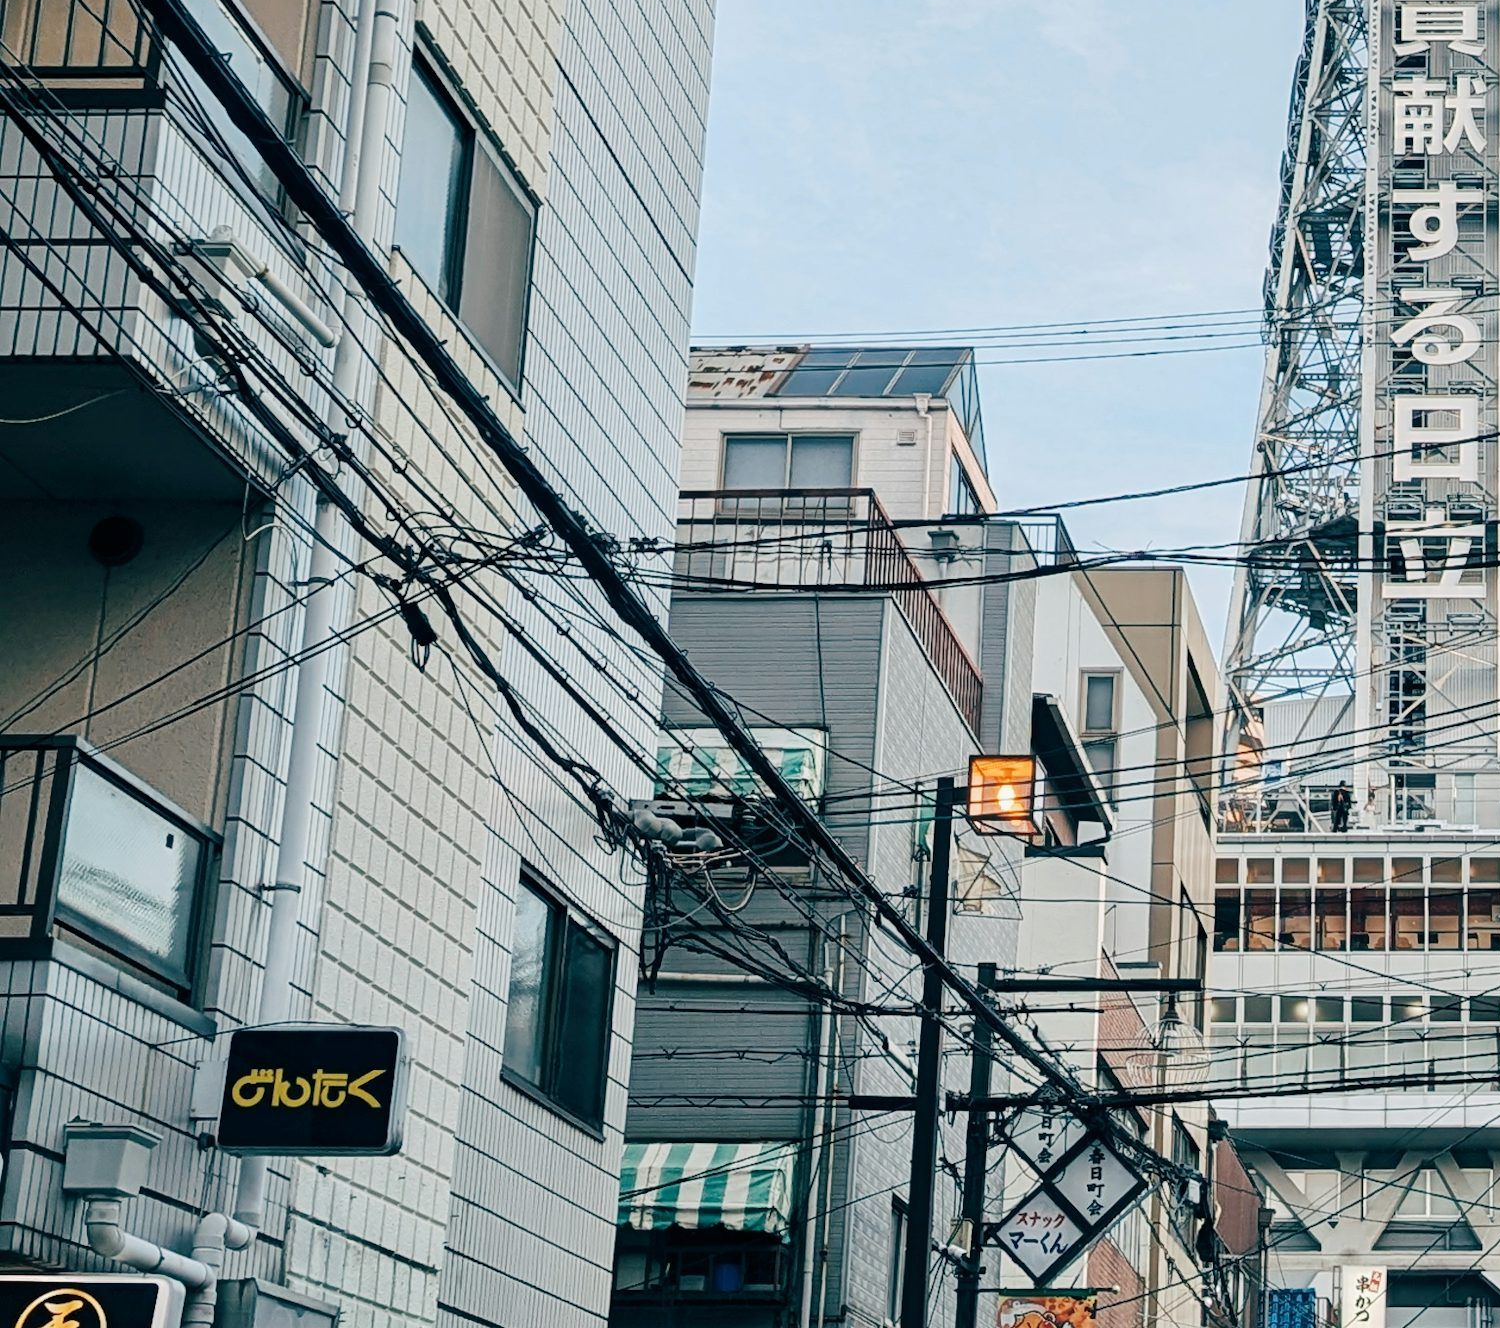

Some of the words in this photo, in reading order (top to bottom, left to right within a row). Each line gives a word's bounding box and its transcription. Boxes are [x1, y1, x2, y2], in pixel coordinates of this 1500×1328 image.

[232, 1068, 386, 1109] どんたく
[1086, 1147, 1106, 1217] 春日町会
[1016, 1211, 1066, 1229] スナック
[1008, 1231, 1069, 1255] マーくん
[1356, 1275, 1371, 1322] 串かつ
